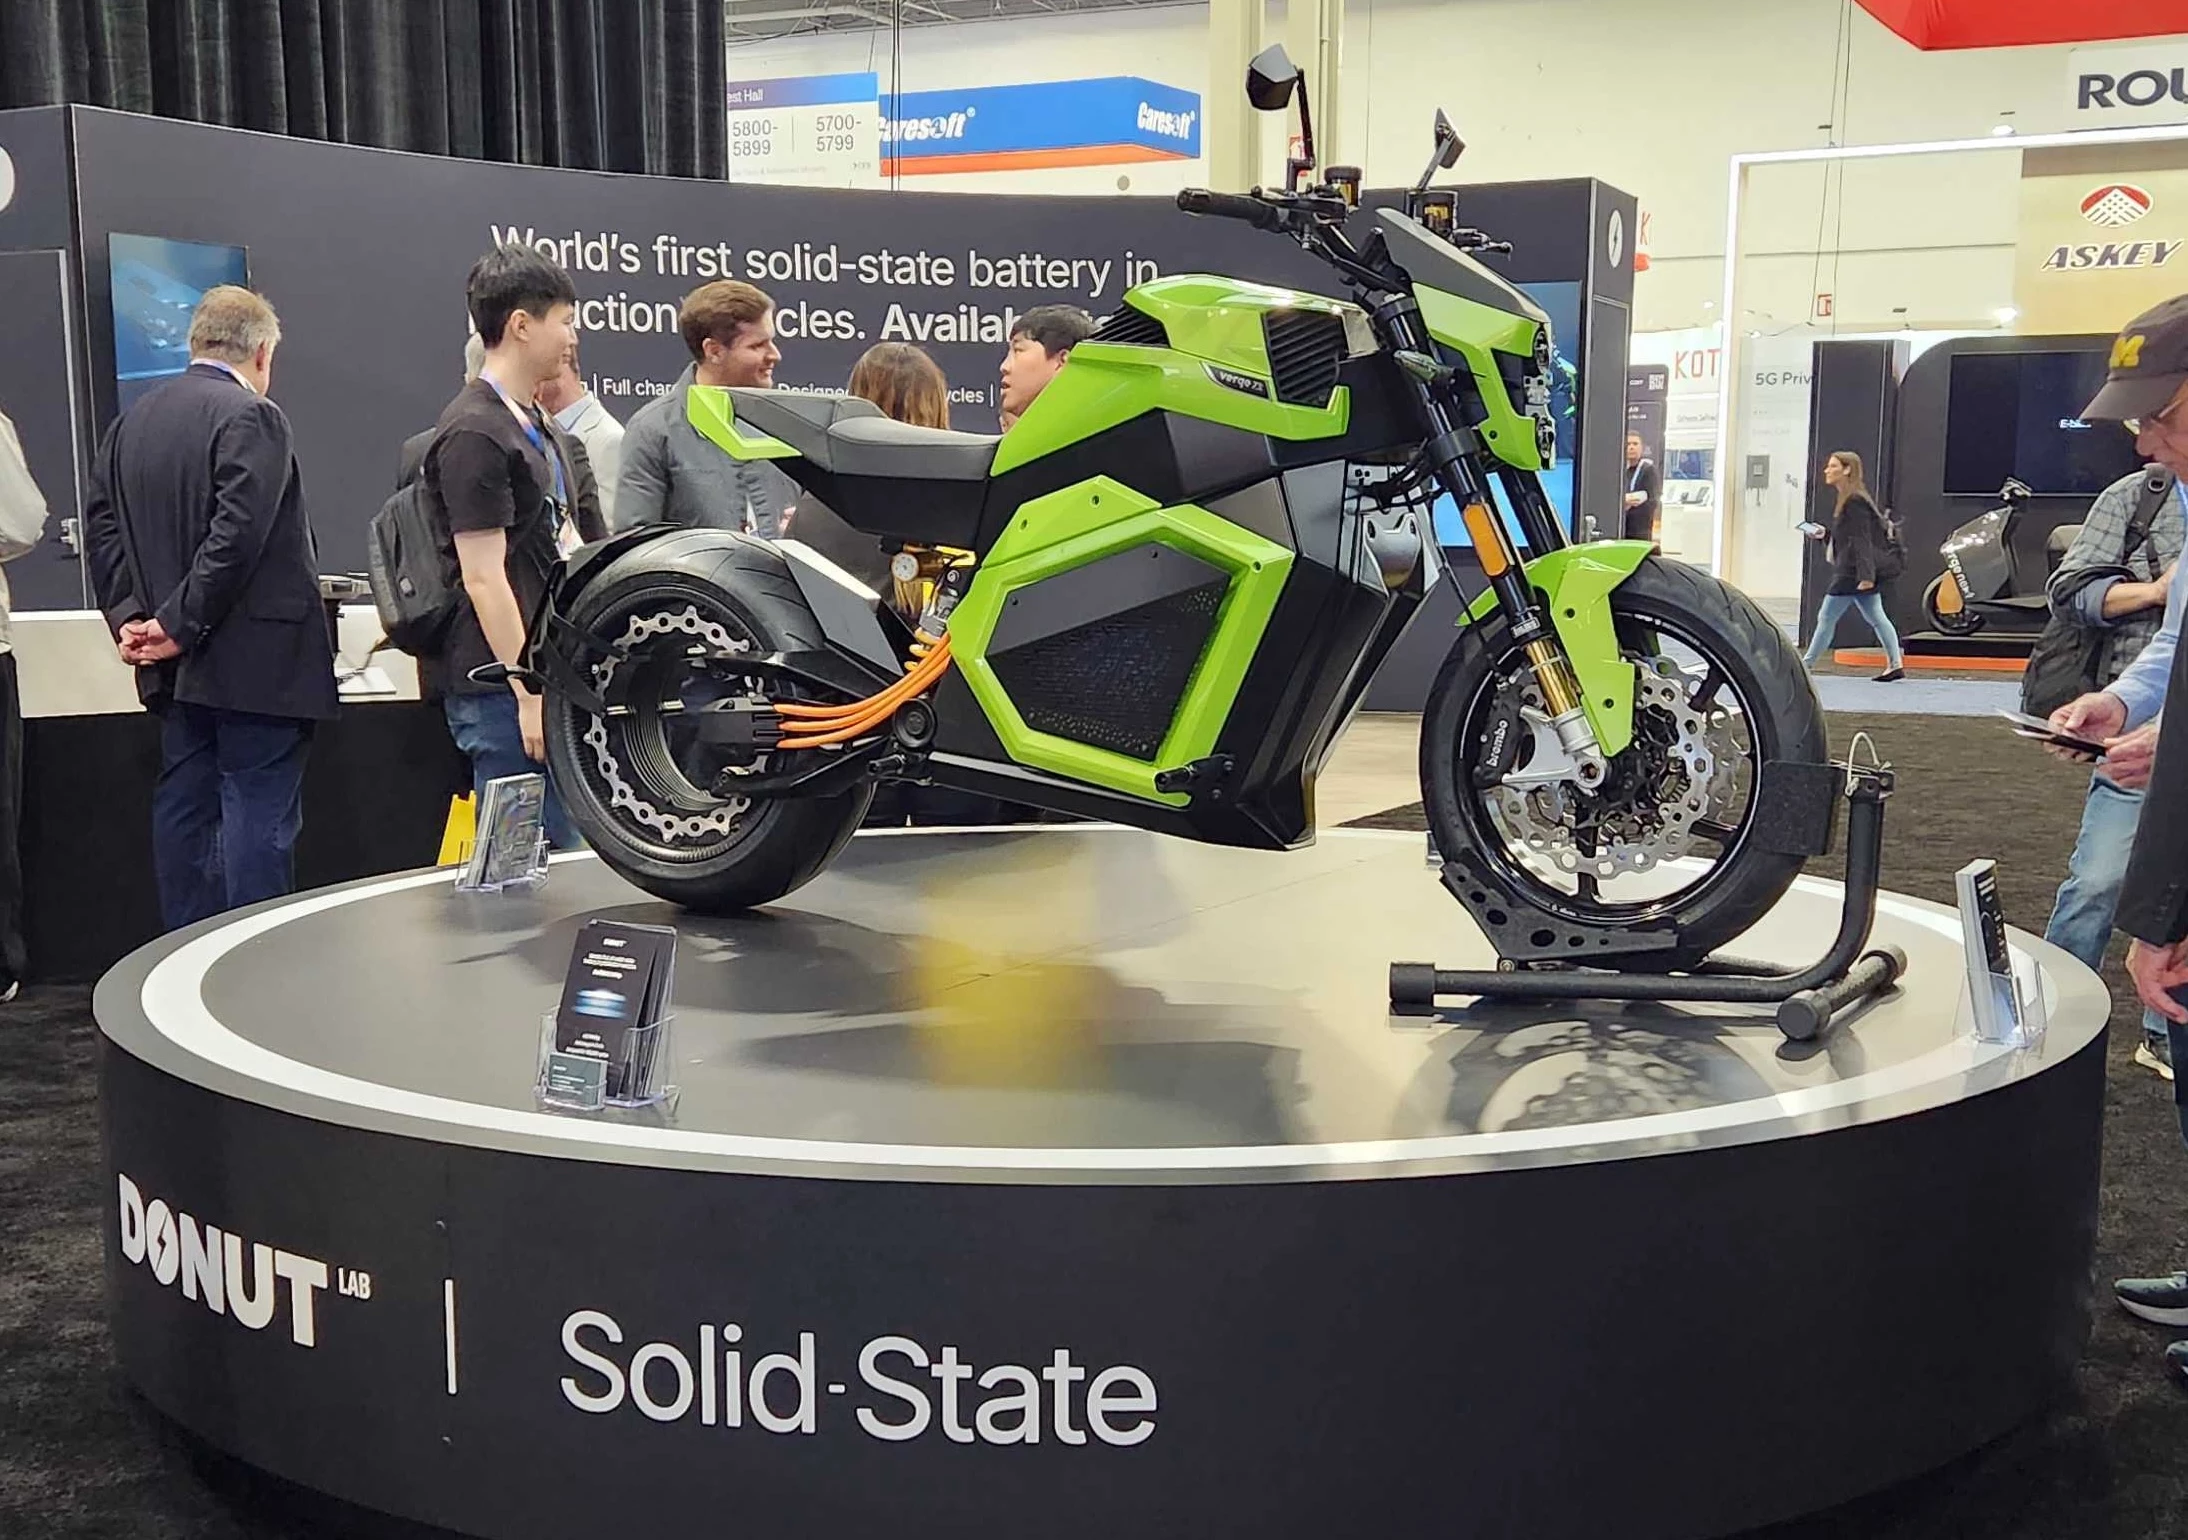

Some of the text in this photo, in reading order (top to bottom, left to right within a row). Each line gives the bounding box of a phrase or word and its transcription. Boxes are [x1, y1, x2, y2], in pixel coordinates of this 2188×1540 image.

[744, 88, 763, 102] Hall
[733, 139, 771, 156] 5899
[816, 134, 854, 152] 5799
[652, 234, 733, 278] first
[745, 243, 955, 287] solid-state
[969, 250, 1112, 298] battery
[1125, 251, 1159, 288] in
[2041, 239, 2184, 271] ASKEY
[602, 378, 631, 396] Full
[1755, 371, 1812, 386] 5G Priv
[1485, 720, 1508, 767] brembo
[118, 1172, 372, 1348] DONUT LAB
[560, 1309, 1158, 1446] Solid-State
